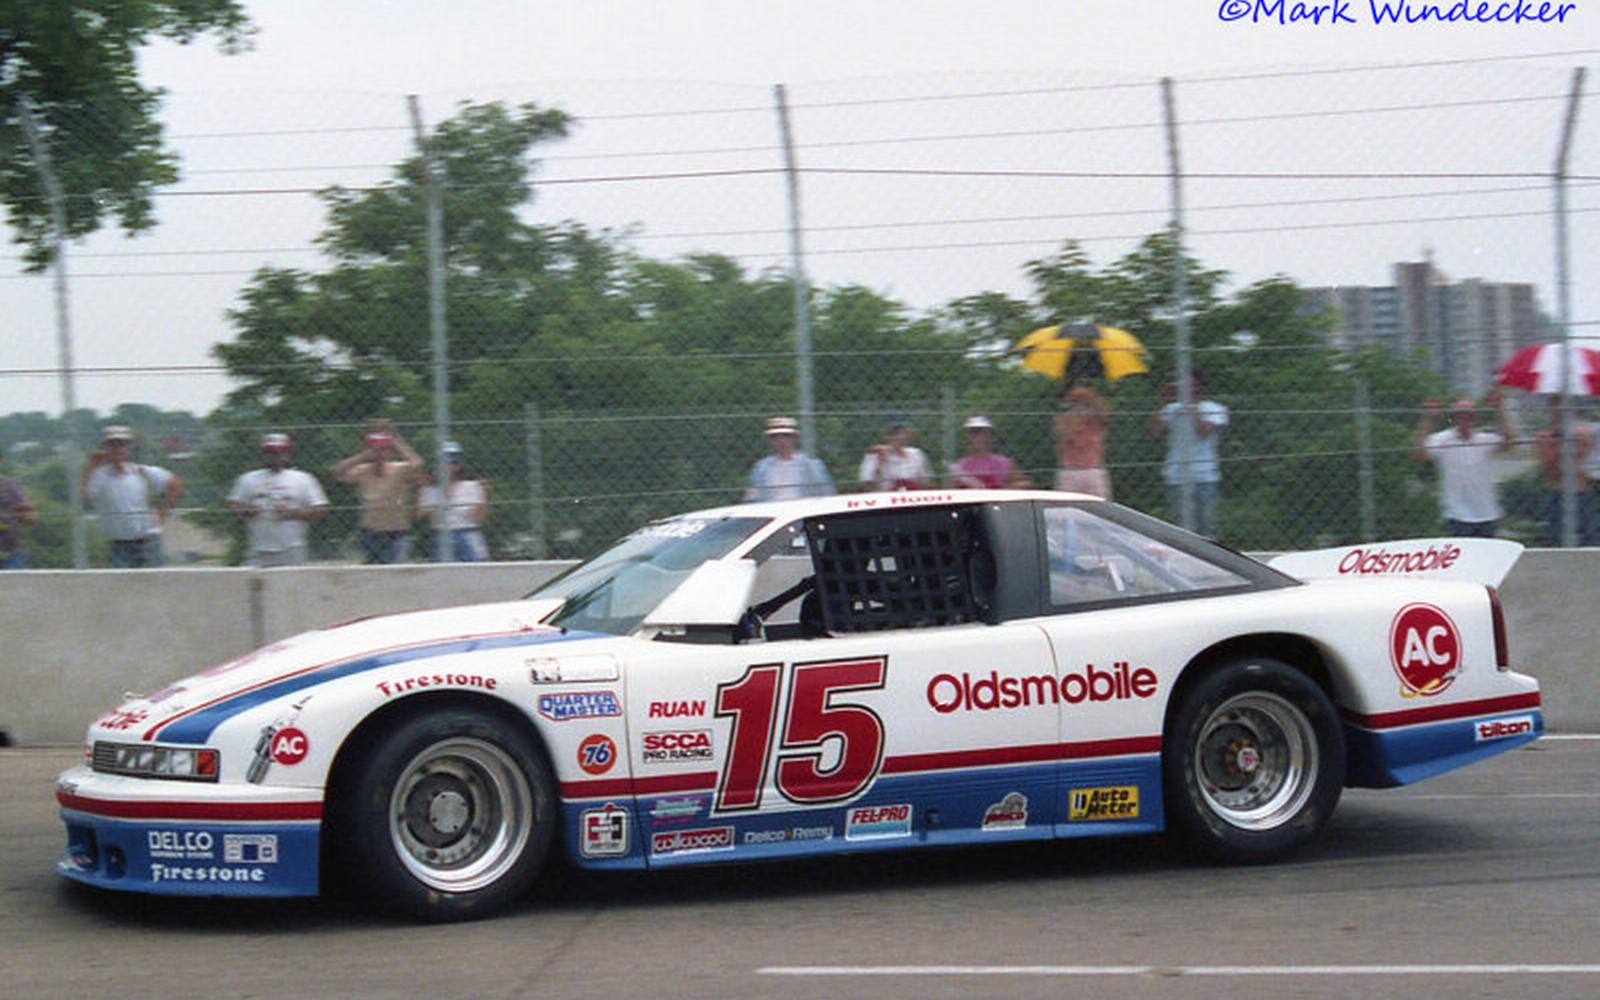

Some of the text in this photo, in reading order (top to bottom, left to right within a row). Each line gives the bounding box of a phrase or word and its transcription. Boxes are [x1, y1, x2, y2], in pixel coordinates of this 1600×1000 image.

[1338, 544, 1461, 574] Oldsmobile
[1401, 625, 1450, 668] AC
[376, 673, 497, 696] Firestone
[927, 662, 1158, 714] Oldsmobile
[540, 692, 613, 712] QUARTER
[554, 702, 618, 718] MASTER
[649, 700, 706, 719] RUAN
[713, 654, 889, 815] 15
[1478, 718, 1532, 739] tilton
[274, 736, 305, 756] AC
[643, 732, 712, 750] SCCA
[584, 742, 612, 765] 76
[644, 747, 713, 761] PRO RACING
[1090, 789, 1130, 803] Auto
[1086, 799, 1137, 816] Meter
[148, 831, 213, 851] DELCO
[656, 828, 730, 852] wilwood
[150, 863, 266, 883] Firestone
